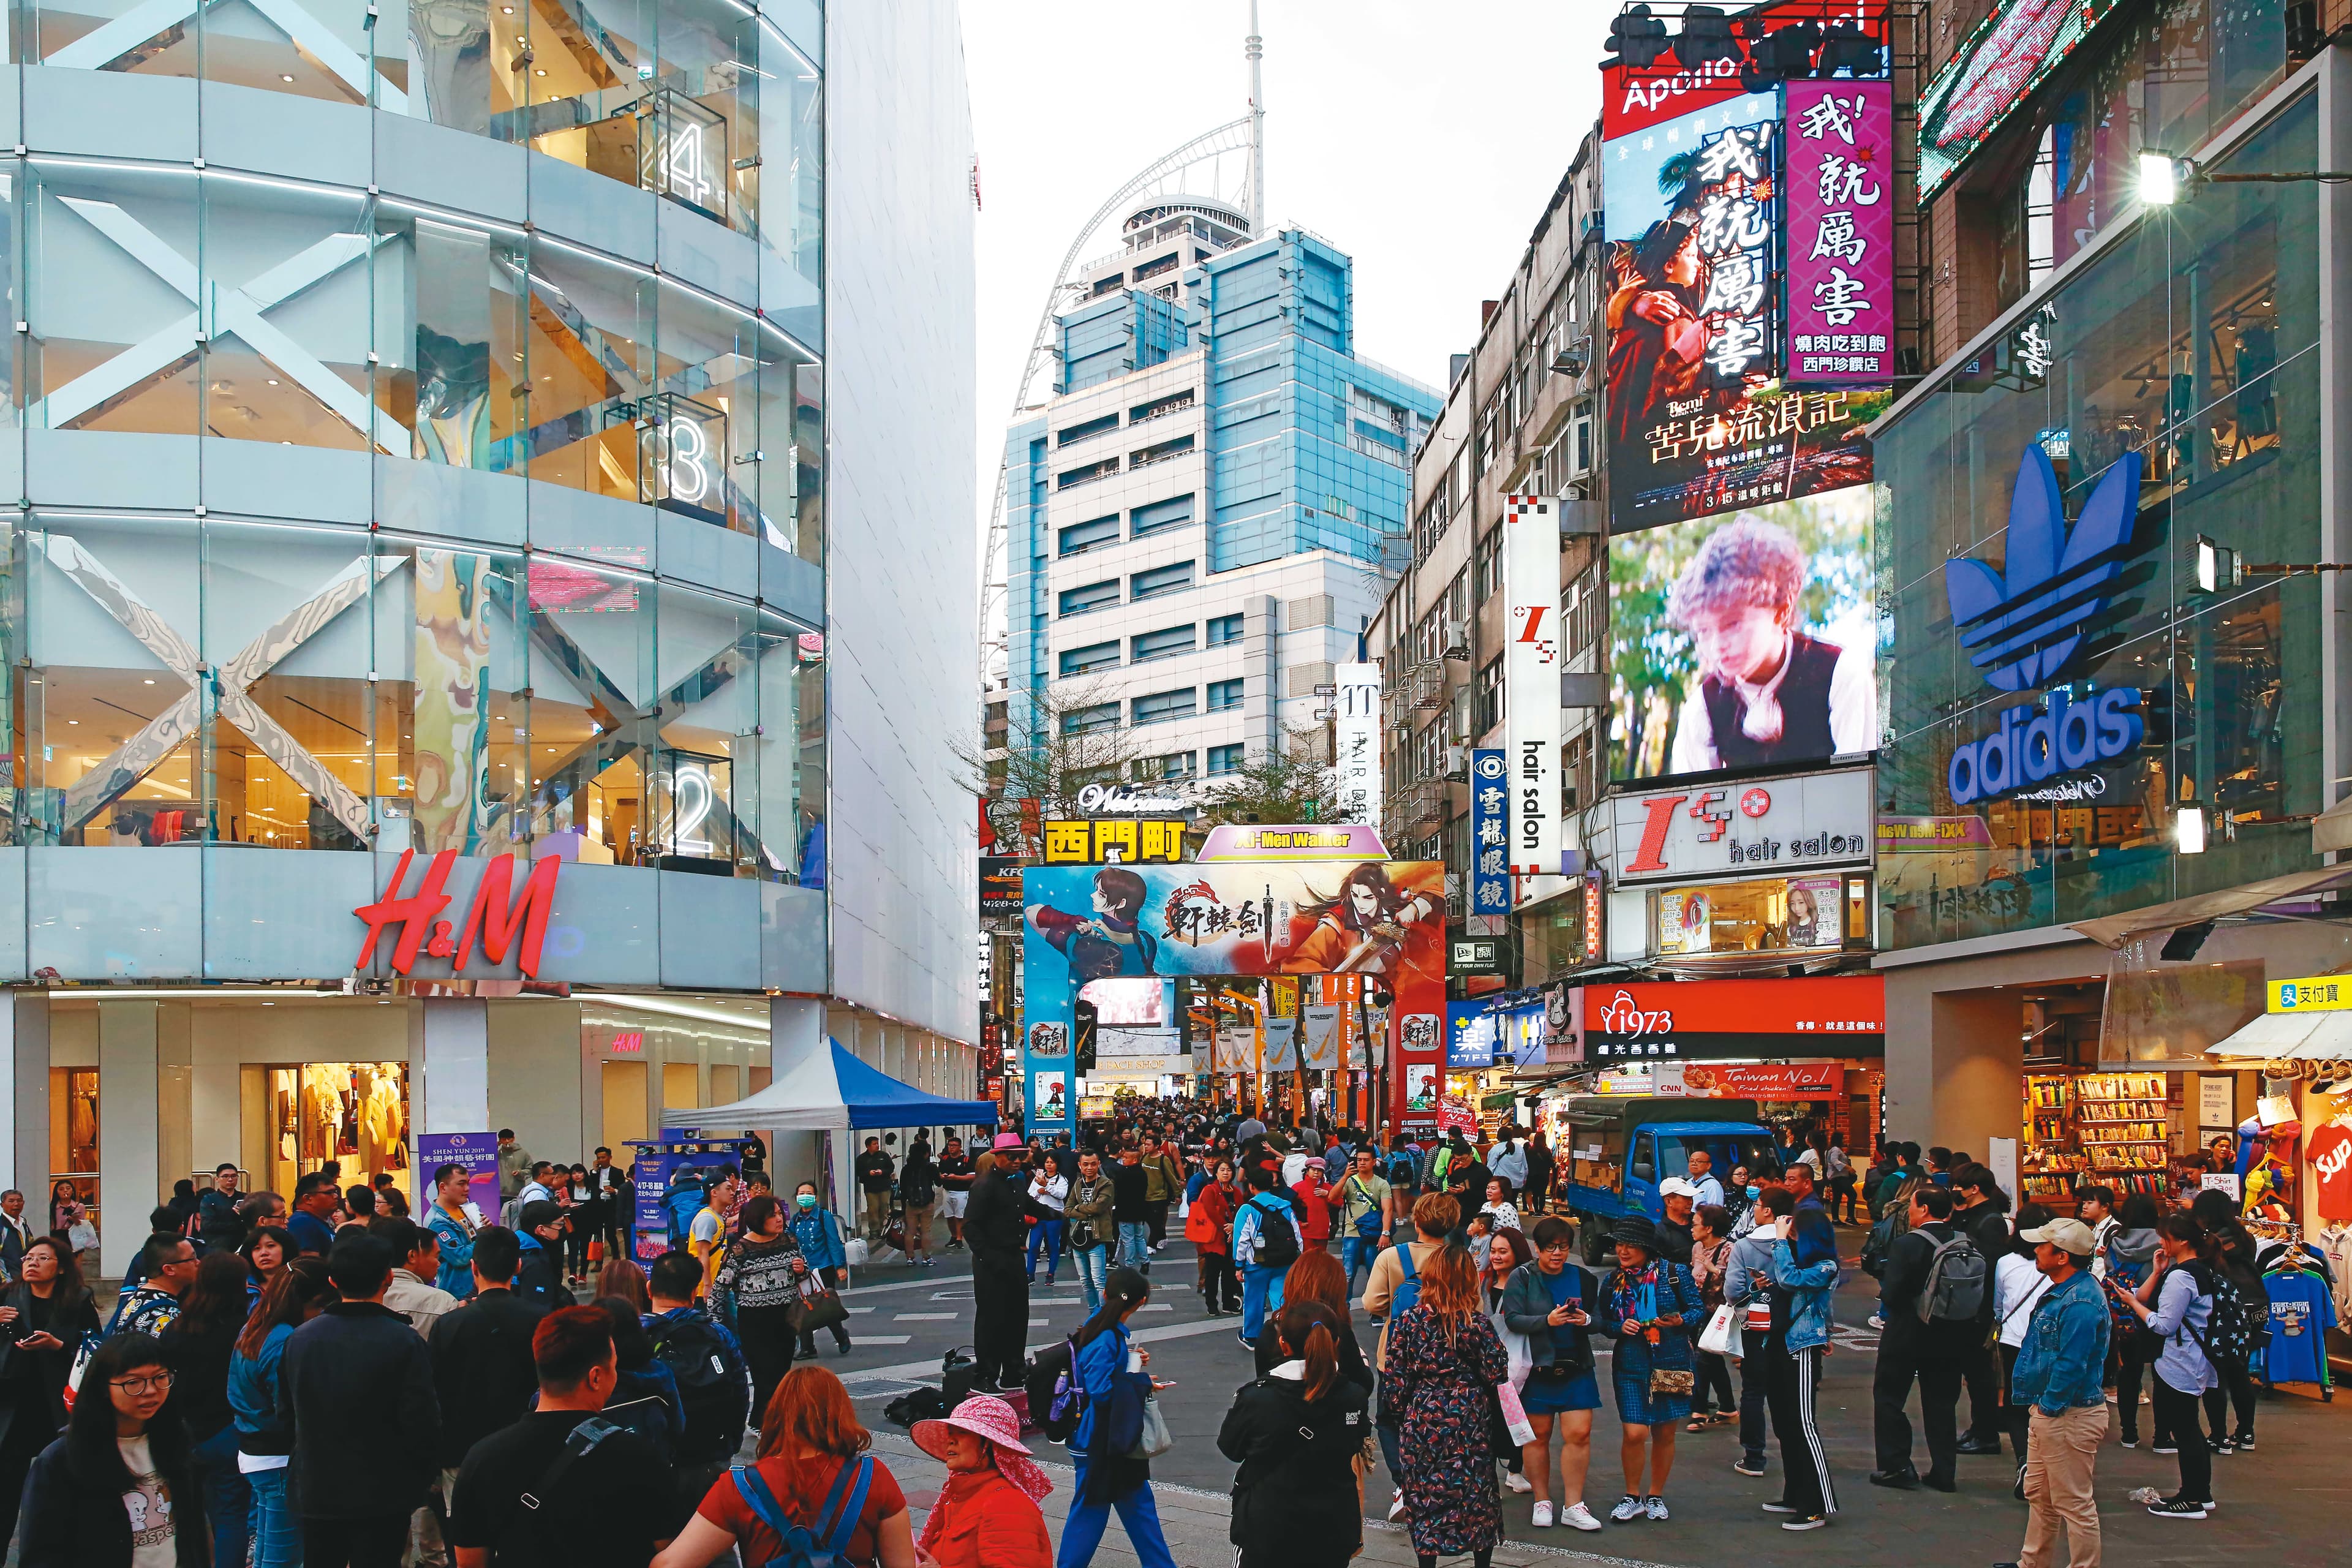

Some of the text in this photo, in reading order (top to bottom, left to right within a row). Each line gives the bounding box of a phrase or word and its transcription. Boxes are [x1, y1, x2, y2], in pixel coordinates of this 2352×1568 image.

[660, 122, 711, 207] 4
[1795, 334, 1887, 353] 燒肉吃到飽
[1645, 391, 1851, 464] 苦兒流浪記
[662, 415, 709, 503] 3
[1706, 491, 1733, 508] 3/15
[1948, 687, 2144, 806] adidas
[1077, 783, 1186, 814] Welcome
[1523, 741, 1546, 849] hair salon
[669, 766, 714, 854] 2
[1046, 821, 1186, 862] 西門町
[1234, 831, 1350, 849] Xi-Men Walker
[1477, 787, 1507, 907] 雪龍眼鏡
[1729, 832, 1863, 862] hair salon
[353, 848, 561, 978] H&M
[2299, 985, 2339, 1003] 支付寶
[612, 1033, 643, 1053] H&M
[1106, 1060, 1133, 1069] FACE
[1136, 1060, 1166, 1069] SHOP
[1450, 1054, 1491, 1062] サツドラ
[1725, 1066, 1830, 1084] Taiwan No.1
[1440, 1106, 1472, 1116] Taiwan
[422, 1154, 495, 1163] 美國神韻藝術團
[2204, 1176, 2231, 1185] T-Shirt
